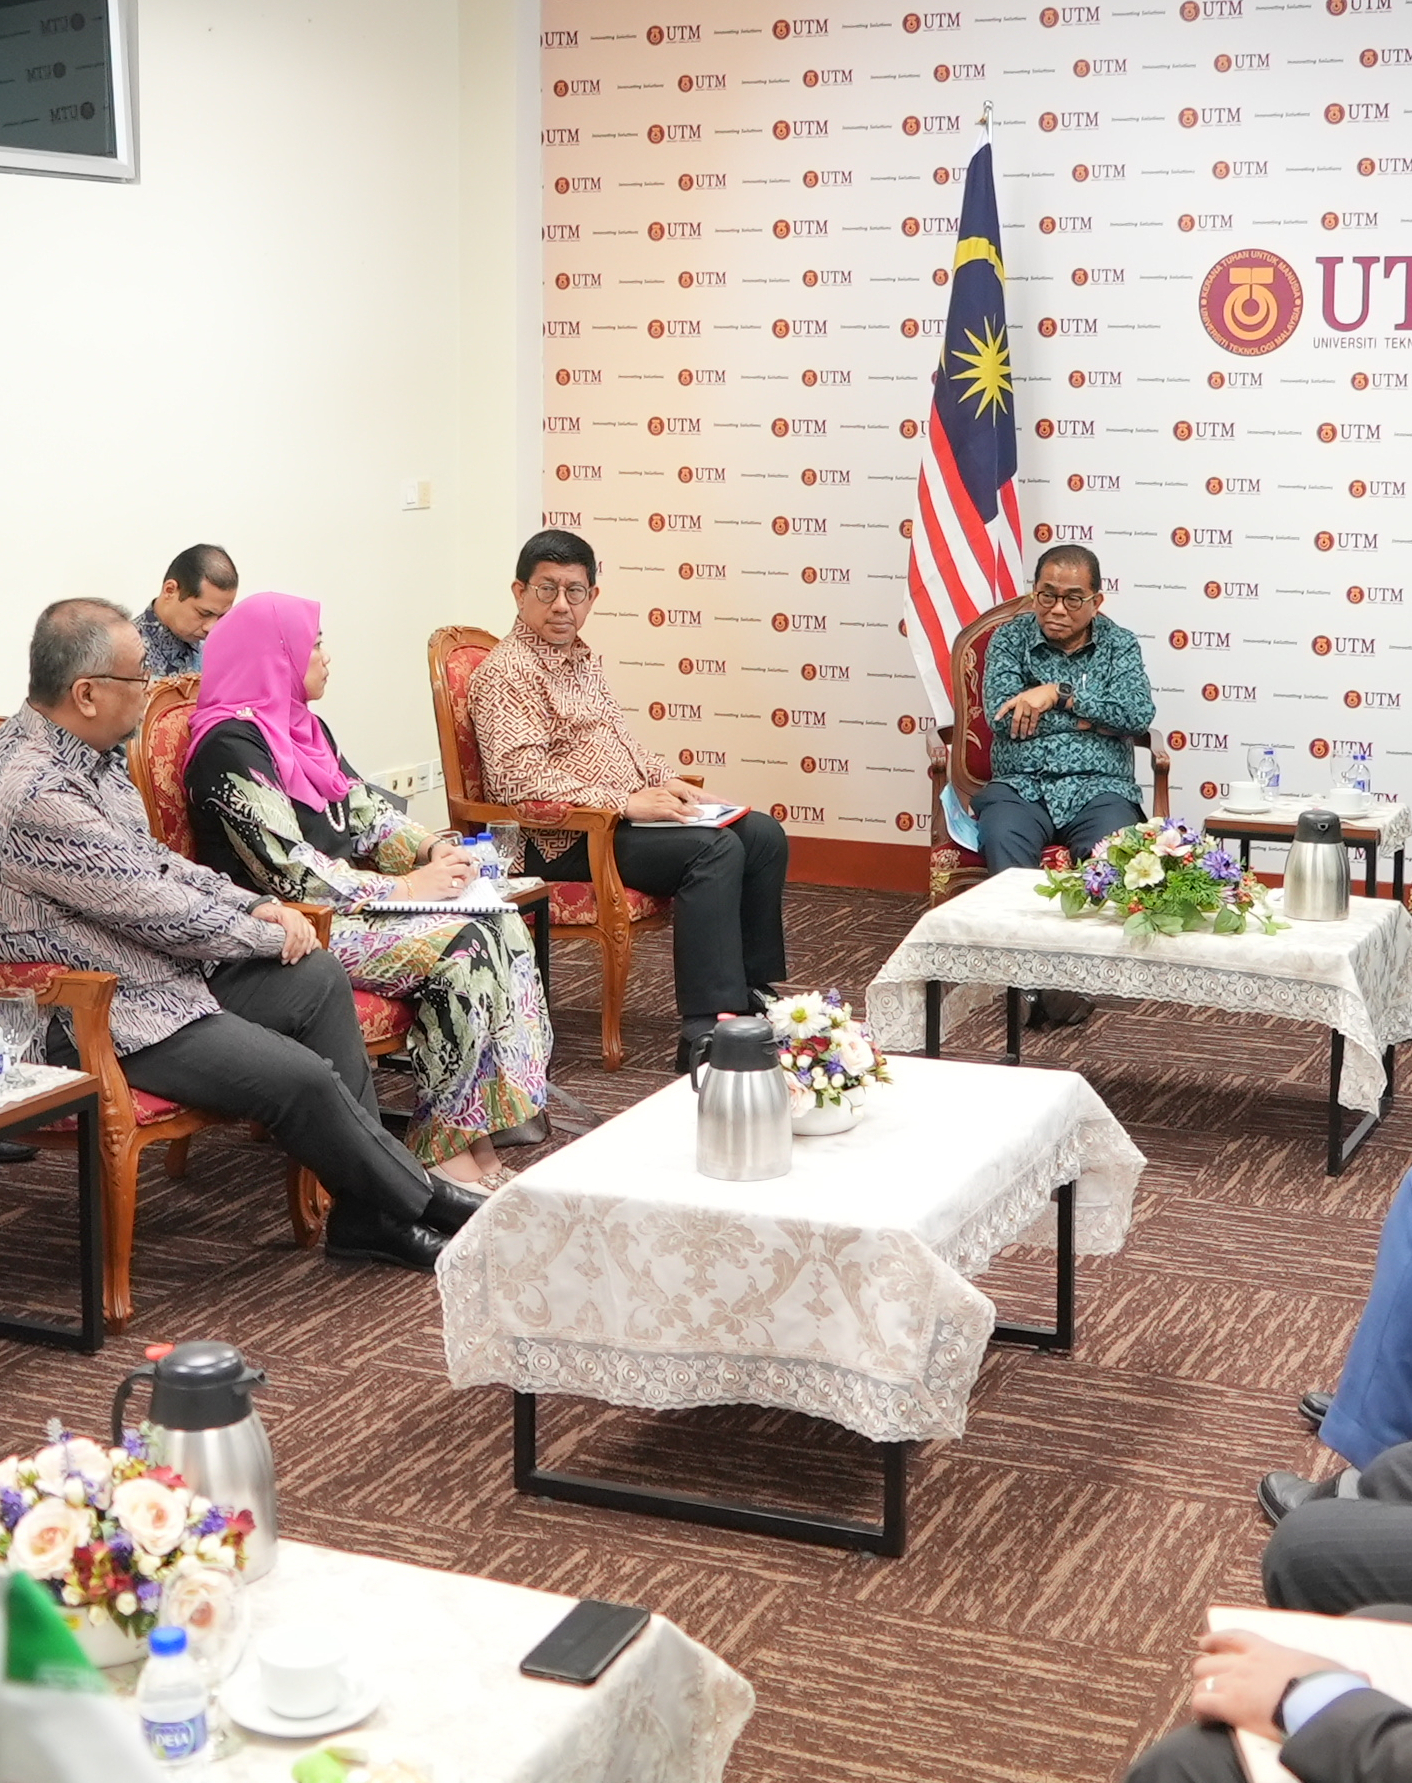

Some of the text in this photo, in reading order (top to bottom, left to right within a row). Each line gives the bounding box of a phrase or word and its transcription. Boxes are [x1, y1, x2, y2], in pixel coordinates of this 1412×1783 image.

[924, 12, 960, 28] UTM
[1062, 6, 1099, 23] UTM
[667, 25, 700, 40] UTM
[793, 19, 828, 35] UTM
[545, 31, 578, 46] UTM
[1093, 59, 1126, 73] UTM
[1235, 54, 1269, 68] UTM
[696, 74, 726, 88] UTM
[821, 69, 852, 84] UTM
[571, 80, 599, 93] UTM
[1202, 108, 1240, 124] UTM
[1348, 103, 1389, 119] UTM
[1061, 112, 1098, 127] UTM
[667, 124, 701, 140] UTM
[794, 120, 828, 135] UTM
[546, 129, 579, 143] UTM
[1092, 164, 1125, 178] UTM
[1233, 161, 1267, 175] UTM
[572, 177, 601, 190] UTM
[696, 174, 726, 187] UTM
[821, 171, 852, 184] UTM
[793, 220, 827, 235] UTM
[1059, 217, 1092, 230] UTM
[1199, 215, 1232, 228] UTM
[547, 225, 580, 239] UTM
[667, 222, 701, 237] UTM
[573, 274, 601, 286] UTM
[696, 272, 726, 285] UTM
[821, 271, 851, 284] UTM
[1092, 269, 1124, 282] UTM
[1201, 250, 1301, 298] KERANA TUHAN UNTUK MANUSIA
[667, 321, 700, 334] UTM
[793, 320, 826, 334] UTM
[1060, 319, 1097, 333] UTM
[1201, 306, 1301, 355] UNIVERSITI TEKNOLOGI MALAYSIA
[1313, 337, 1377, 349] UNIVERSITI
[572, 370, 601, 382] UTM
[696, 370, 725, 383] UTM
[820, 371, 851, 383] UTM
[1228, 373, 1262, 386] UTM
[1373, 374, 1407, 387] UTM
[548, 417, 580, 430] UTM
[667, 418, 700, 432] UTM
[1057, 420, 1094, 435] UTM
[1196, 422, 1234, 437] UTM
[1341, 424, 1380, 439] UTM
[573, 465, 601, 478] UTM
[819, 470, 850, 483] UTM
[1087, 475, 1120, 488] UTM
[1226, 479, 1260, 492] UTM
[1370, 481, 1405, 495] UTM
[549, 512, 581, 526] UTM
[668, 515, 701, 529] UTM
[1056, 525, 1093, 540] UTM
[1194, 529, 1232, 544] UTM
[1338, 533, 1377, 548] UTM
[820, 568, 850, 581] UTM
[1224, 583, 1258, 596] UTM
[1368, 588, 1403, 602] UTM
[792, 615, 826, 629] UTM
[1192, 631, 1230, 647] UTM
[1335, 637, 1375, 653] UTM
[696, 660, 726, 673] UTM
[819, 665, 849, 679] UTM
[1222, 685, 1256, 699] UTM
[668, 704, 701, 718] UTM
[792, 710, 825, 725] UTM
[1190, 733, 1228, 749] UTM
[696, 751, 725, 764] UTM
[819, 758, 848, 772] UTM
